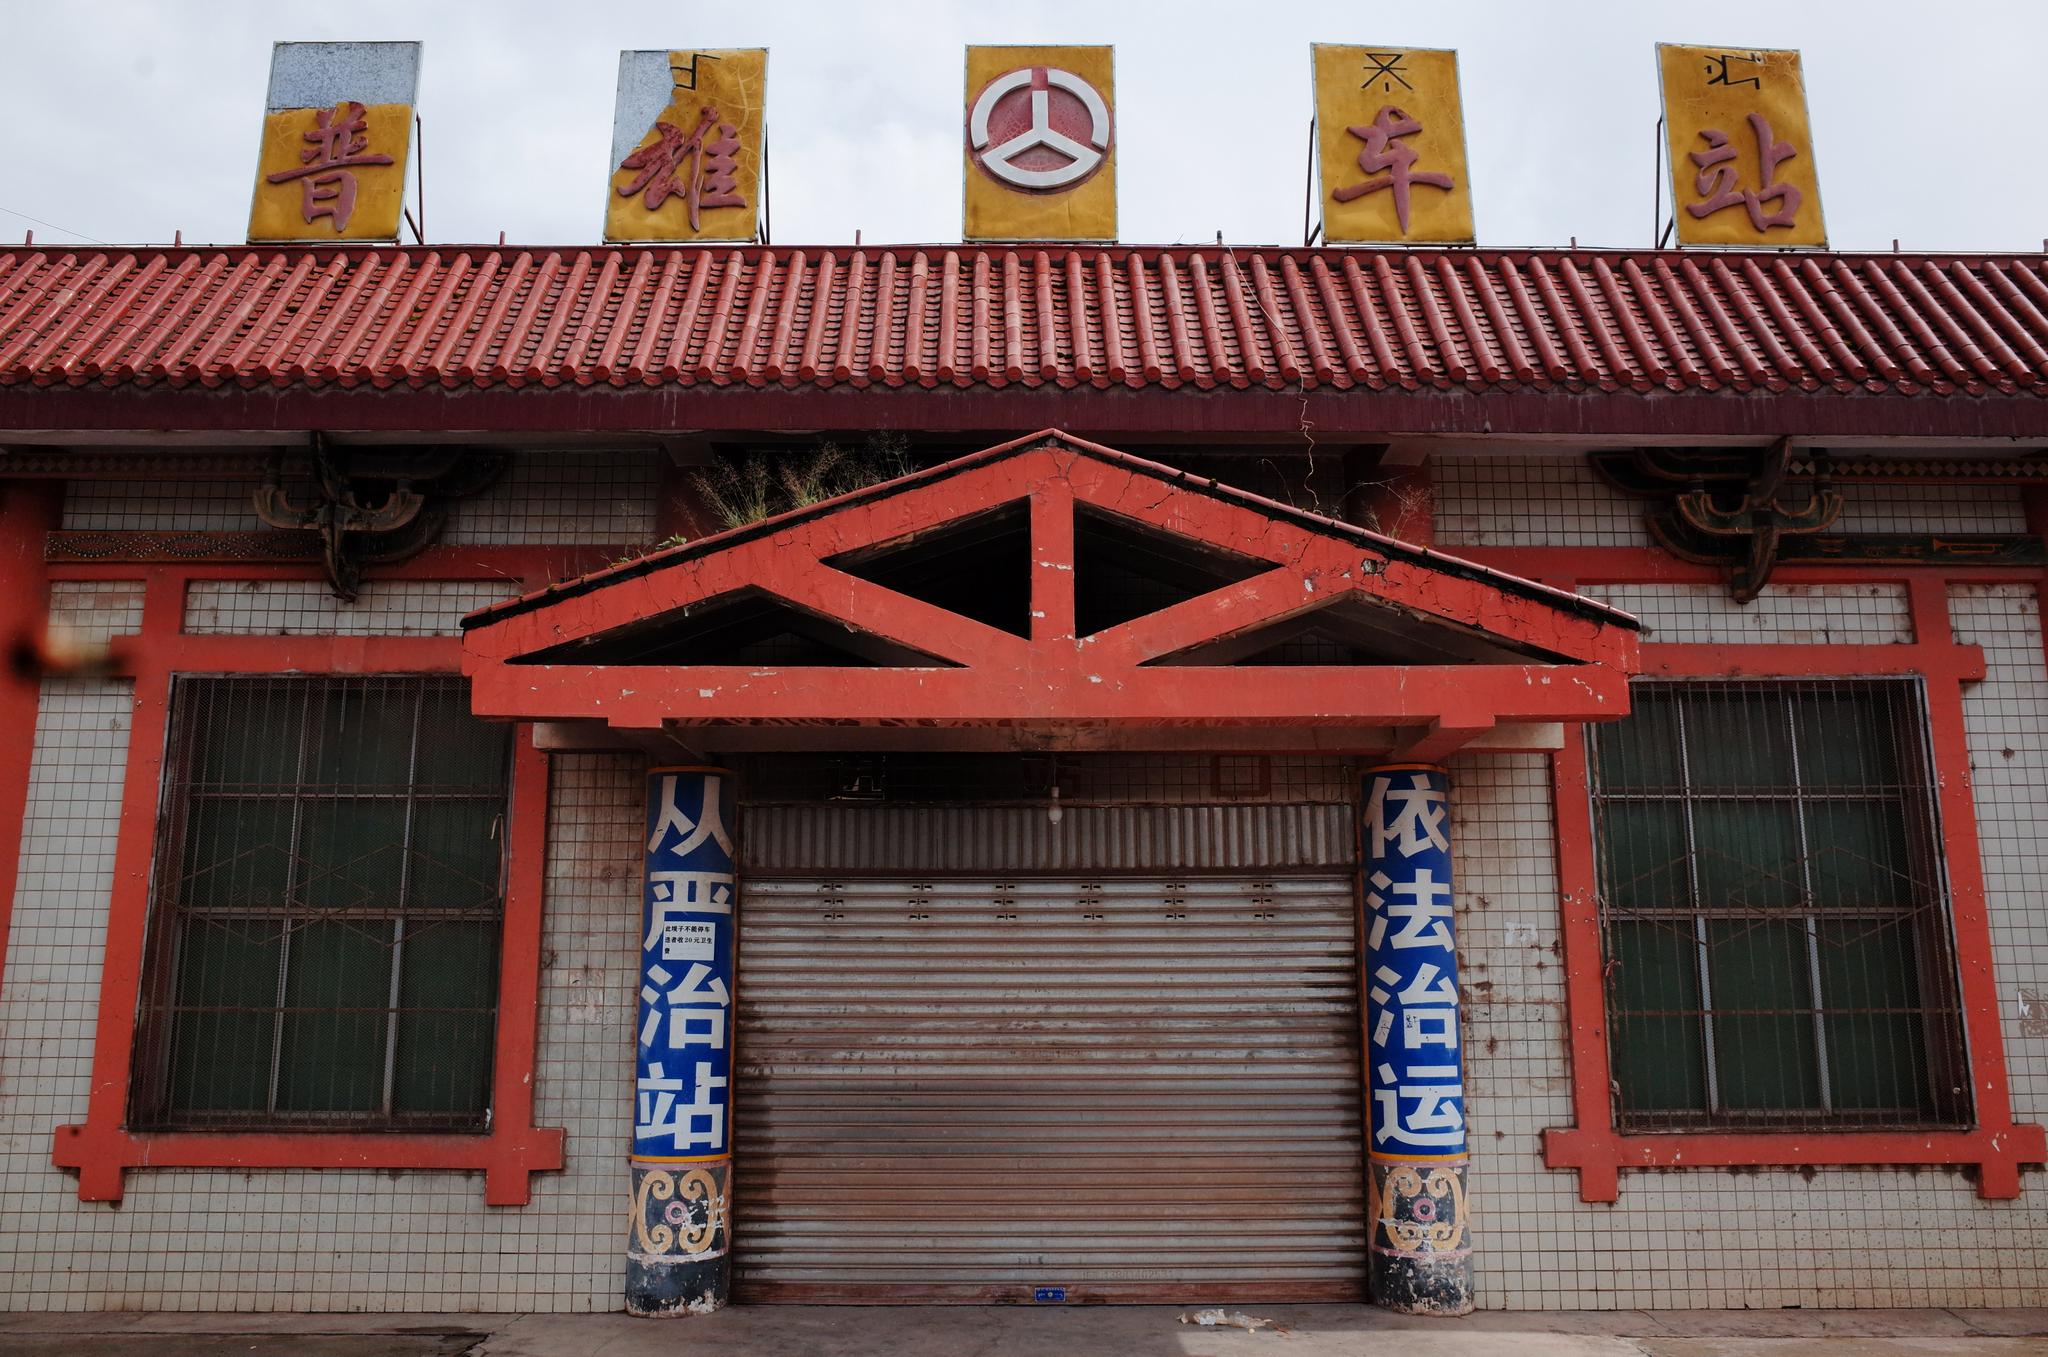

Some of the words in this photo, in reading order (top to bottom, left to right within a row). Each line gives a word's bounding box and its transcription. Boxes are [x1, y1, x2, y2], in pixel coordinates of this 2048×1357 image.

[266, 100, 395, 232] 普
[617, 106, 747, 232] 雄
[1332, 104, 1455, 234] 车
[1686, 112, 1803, 232] 站
[635, 774, 734, 1151] 从严治站
[1363, 773, 1465, 1147] 依法治运
